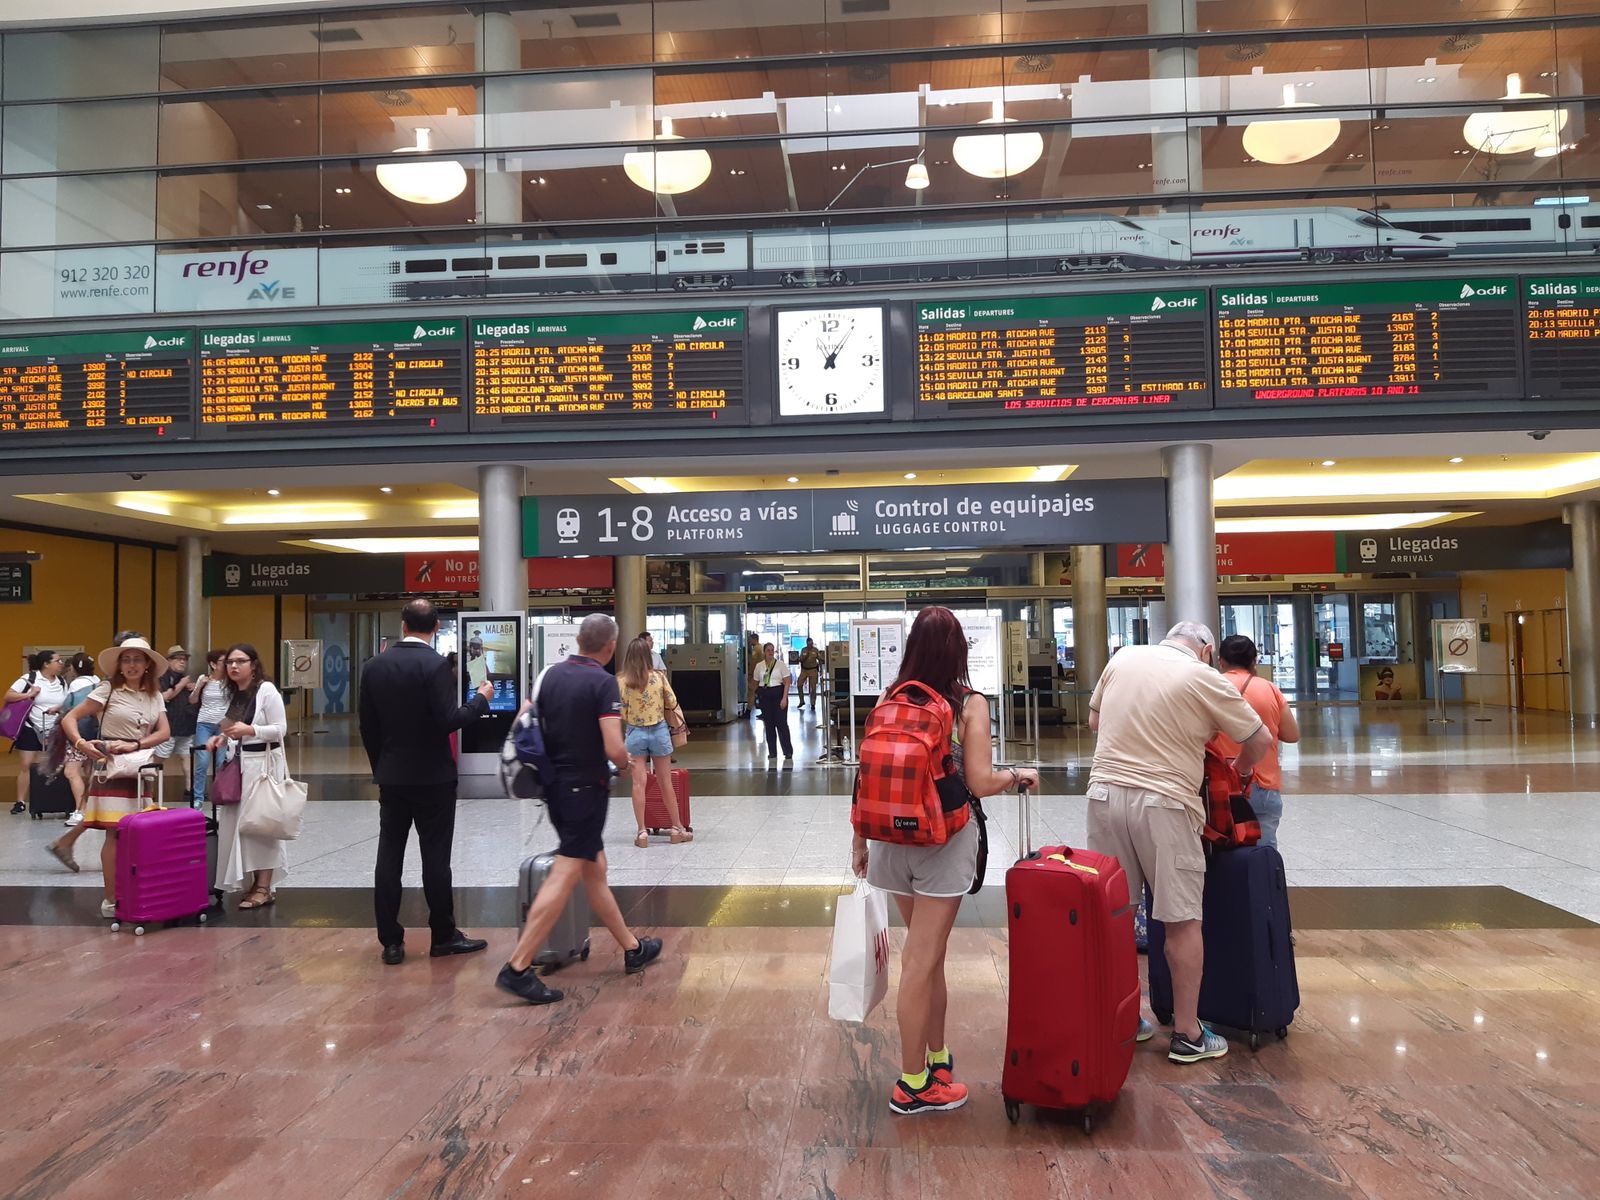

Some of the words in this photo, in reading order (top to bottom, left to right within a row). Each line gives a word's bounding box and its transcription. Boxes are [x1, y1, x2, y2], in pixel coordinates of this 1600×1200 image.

[1194, 224, 1240, 239] renfe
[61, 269, 87, 282] 912
[92, 267, 118, 280] 320
[124, 265, 150, 280] 320
[182, 251, 268, 284] renfe
[60, 284, 149, 299] www.renfe.com
[247, 280, 296, 301] AVE
[1476, 286, 1508, 296] adif
[1530, 283, 1577, 296] Salidas
[1167, 298, 1198, 308] adif
[1222, 293, 1268, 306] Salidas
[1276, 295, 1319, 303] DEPARTURES
[921, 308, 966, 320] Salidas
[974, 309, 1015, 317] DEPARTURES
[1219, 319, 1246, 328] 16:02
[1247, 318, 1280, 326] MADRID
[1310, 316, 1342, 324] ATOCHA
[1344, 315, 1360, 323] AVE
[1432, 312, 1438, 320] 2
[1528, 310, 1554, 318] 20:05
[1557, 309, 1589, 318] MADRID
[708, 318, 737, 328] adif
[820, 320, 840, 332] 12
[1528, 320, 1555, 328] 20:13
[1558, 319, 1595, 328] SEVILLA
[428, 327, 456, 336] adif
[476, 324, 530, 338] Llegadas
[919, 333, 944, 342] 11:02
[946, 332, 977, 341] MADRID
[1006, 330, 1038, 338] ATOCHA
[1039, 328, 1055, 336] AVE
[1084, 326, 1106, 334] 2113
[1529, 330, 1556, 338] 21:20
[1558, 330, 1590, 338] MADRID
[158, 337, 186, 346] adif
[204, 333, 256, 348] Llegadas
[919, 344, 944, 352] 12:05
[946, 342, 977, 350] MADRID
[1006, 340, 1038, 348] ATOCHA
[1039, 338, 1056, 346] AVE
[1085, 336, 1106, 344] 2123
[501, 348, 530, 356] MADRID
[558, 346, 588, 354] ATOCHA
[589, 345, 604, 353] AVE
[675, 342, 686, 350] NO
[690, 342, 724, 350] CIRCULA
[920, 354, 944, 362] 13:22
[946, 352, 982, 360] SEVILLA
[1080, 346, 1106, 354] 13905
[1220, 350, 1246, 358] 18:10
[1248, 348, 1280, 357] MADRID
[1311, 346, 1344, 354] ATOCHA
[1346, 345, 1362, 353] AVE
[226, 358, 256, 366] MADRID
[312, 354, 327, 362] AVE
[388, 352, 394, 360] 4
[788, 358, 800, 370] 9
[861, 355, 874, 367] 3
[1220, 360, 1246, 368] 18:20
[1248, 358, 1286, 367] SEVILLA
[1317, 356, 1344, 364] JUSTA
[1346, 355, 1372, 364] AVANT
[1432, 353, 1438, 361] 1
[126, 370, 136, 378] NO
[140, 369, 172, 378] CIRCULA
[920, 373, 945, 382] 14:15
[947, 372, 982, 380] SEVILLA
[1012, 370, 1038, 378] JUSTA
[1040, 368, 1066, 376] AVANT
[502, 385, 546, 394] BARCELONA
[549, 384, 574, 392] SANTS
[948, 391, 994, 400] BARCELONA
[998, 390, 1024, 398] SANTS
[1040, 388, 1056, 396] AVE
[1086, 386, 1106, 394] 3991
[1142, 383, 1184, 392] ESTIMADO
[1255, 389, 1314, 399] UNDERGROUND
[1318, 387, 1368, 398] PLATFORMS
[1386, 386, 1404, 395] AND
[1408, 386, 1420, 394] 11
[442, 398, 458, 406] BUS
[826, 393, 838, 406] 6
[1005, 401, 1022, 409] LOS
[1026, 399, 1072, 408] SERVICIOS
[1076, 398, 1088, 406] DE
[667, 506, 732, 523] Acceso
[740, 508, 750, 521] a
[758, 502, 798, 521] vías
[874, 498, 948, 518] Control
[956, 498, 982, 516] de
[990, 494, 1095, 518] equipajes
[597, 506, 654, 542] 1-8
[875, 522, 940, 535] LUGGAGE
[944, 520, 1006, 533] CONTROL
[667, 528, 744, 540] PLATFORMS
[1389, 536, 1458, 552] Llegadas
[1390, 554, 1434, 564] ARRIVALS
[250, 562, 310, 579] Llegadas
[445, 560, 464, 572] No
[251, 578, 288, 588] ARRIVALS
